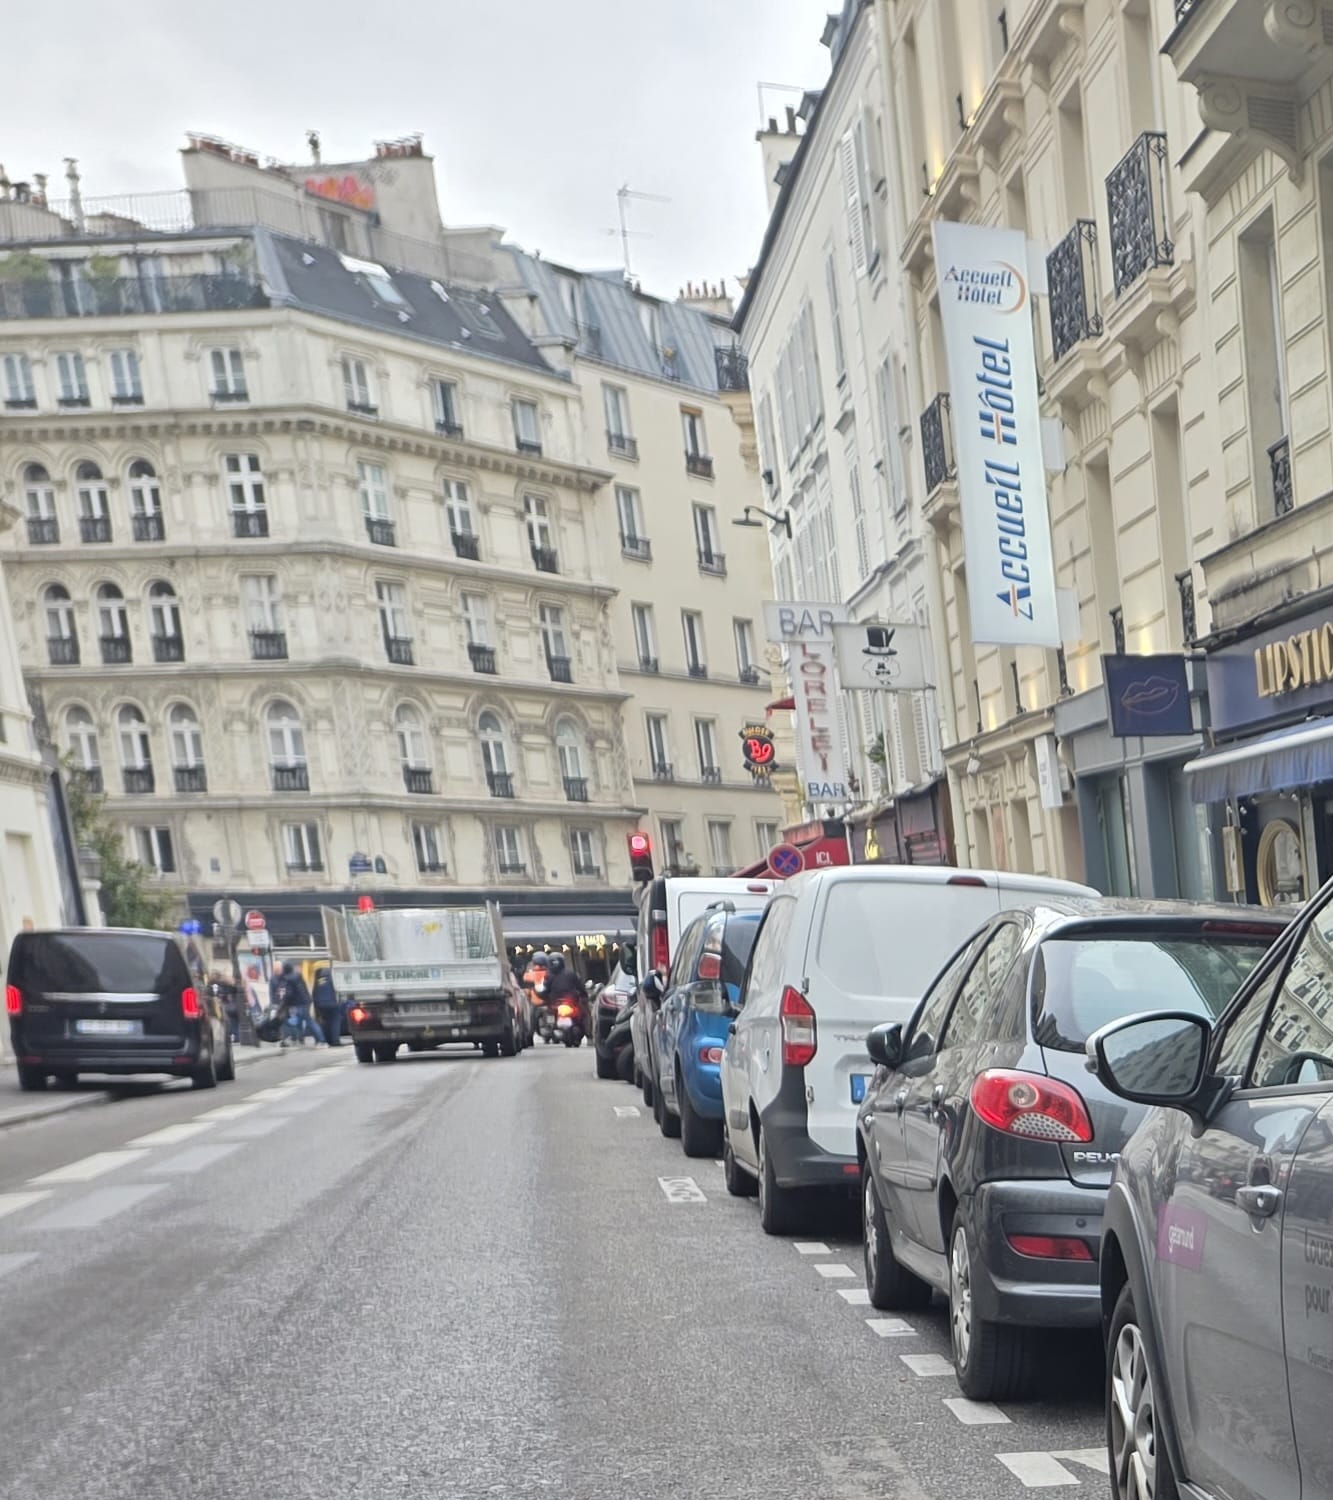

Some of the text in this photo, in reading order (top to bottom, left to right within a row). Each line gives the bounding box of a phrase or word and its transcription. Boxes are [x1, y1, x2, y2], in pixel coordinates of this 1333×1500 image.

[944, 265, 1013, 288] Accueil
[972, 335, 1034, 621] Accueil Hôtel
[800, 643, 832, 772] LORELEY
[808, 782, 847, 798] BAR
[1304, 1283, 1331, 1320] pour
